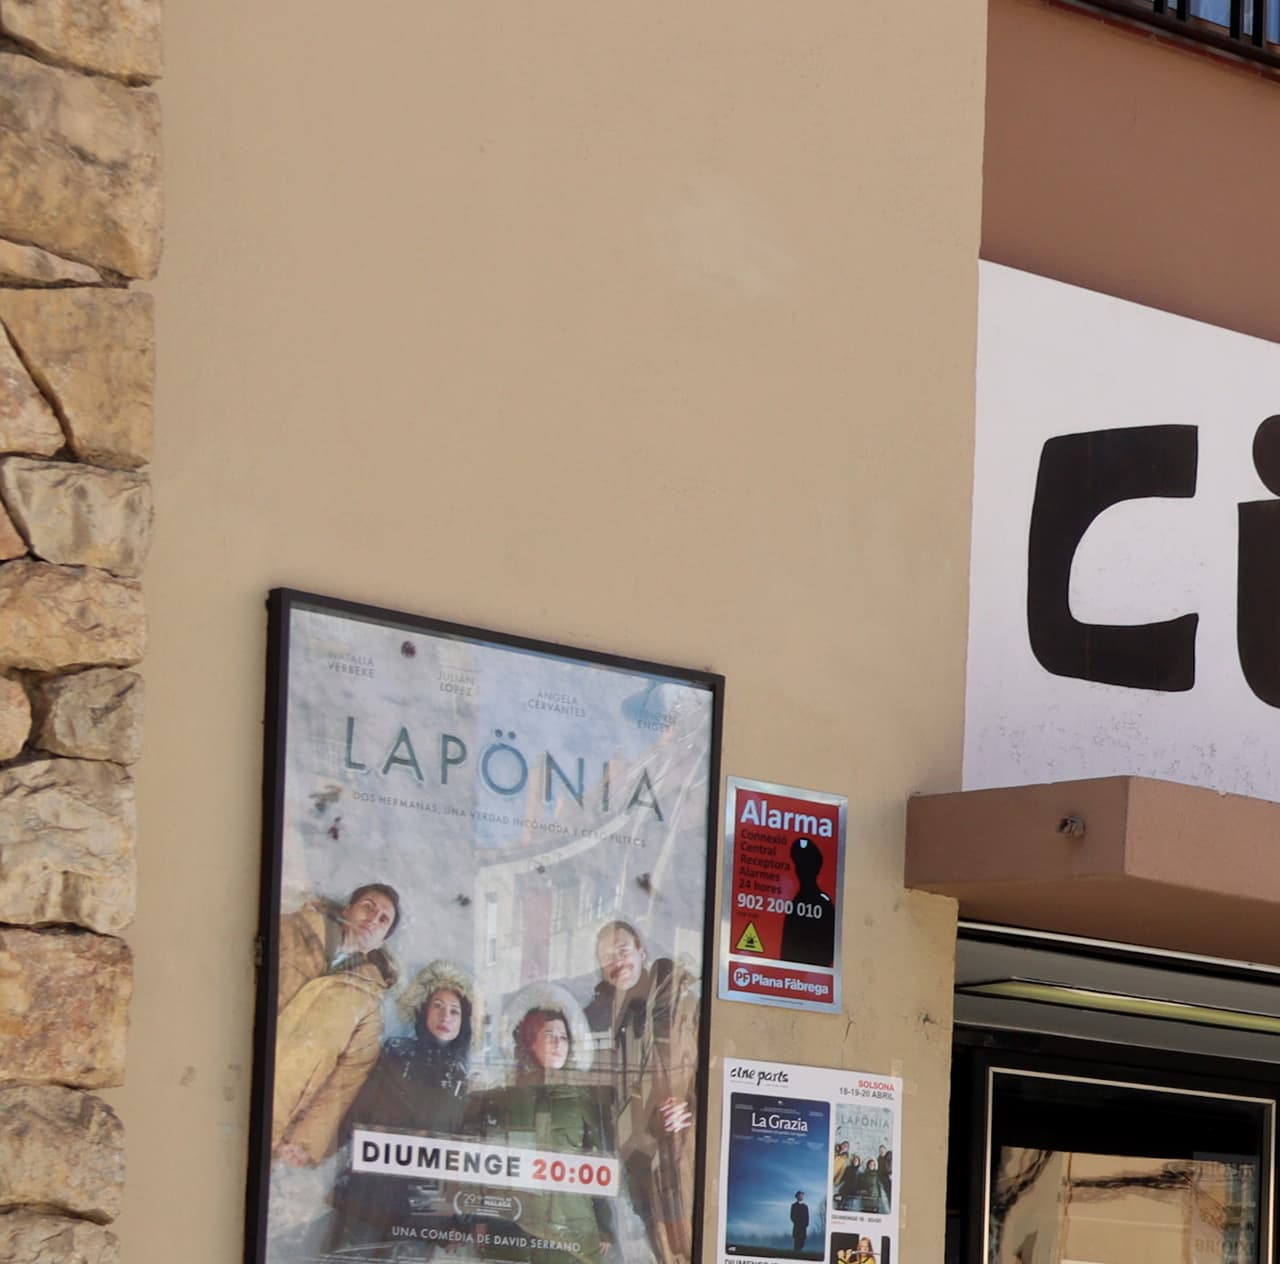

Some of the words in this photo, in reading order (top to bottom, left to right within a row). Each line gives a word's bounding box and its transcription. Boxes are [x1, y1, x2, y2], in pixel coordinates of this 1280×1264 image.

[344, 716, 664, 823] LAPÖNIA
[740, 799, 833, 837] Alarma
[741, 841, 777, 856] Central
[740, 854, 791, 871] Receptora
[739, 866, 780, 882] Alarmes
[739, 878, 751, 889] 24
[754, 880, 782, 895] hores
[737, 893, 764, 911] 902
[767, 897, 794, 915] 200
[797, 902, 822, 919] 010
[751, 973, 784, 988] Plana
[858, 1079, 895, 1092] SOLSONA
[872, 1090, 895, 1100] ABRIL
[751, 1112, 767, 1128] La
[768, 1114, 808, 1132] Grazia
[362, 1140, 521, 1178] DIUMENGE
[532, 1158, 612, 1187] 20:00
[391, 1226, 418, 1238] UNA
[477, 1234, 491, 1245] DE
[493, 1235, 527, 1248] DAVID
[530, 1238, 582, 1252] SERRANO
